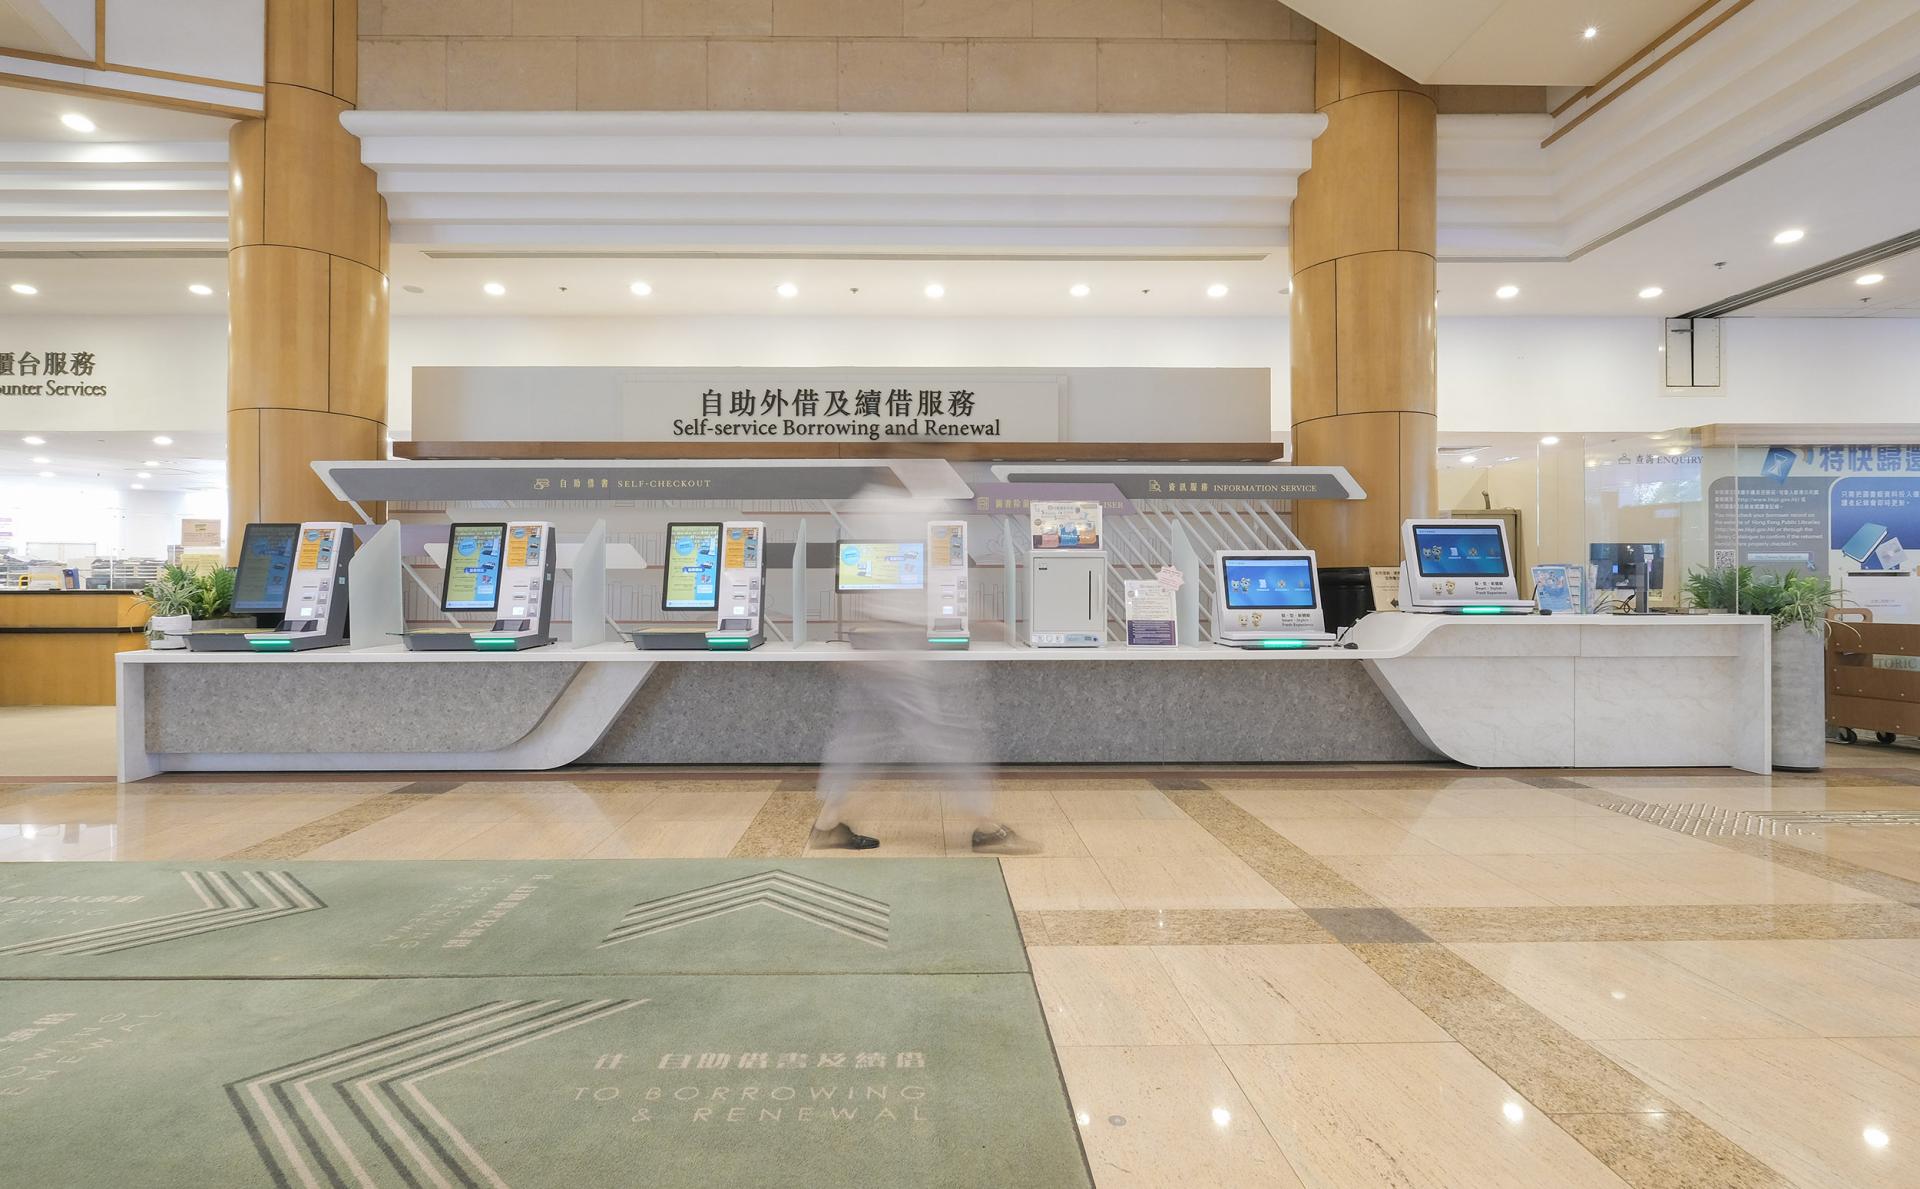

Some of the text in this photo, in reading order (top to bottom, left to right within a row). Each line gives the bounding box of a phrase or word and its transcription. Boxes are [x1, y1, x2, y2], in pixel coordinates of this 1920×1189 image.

[0, 351, 96, 376] 櫃台服務
[0, 379, 107, 396] unter Services
[701, 388, 976, 418] 自助外借及續借服務
[672, 418, 1001, 440] Self-service Borrowing and Renewal
[1657, 455, 1703, 464] ENQUIRY
[617, 479, 712, 488] SELF-CHECKOUT
[1213, 484, 1317, 493] INFORMATION SERVICE
[575, 1085, 926, 1101] TO BORROWING
[692, 1106, 929, 1122] RENEWAL
